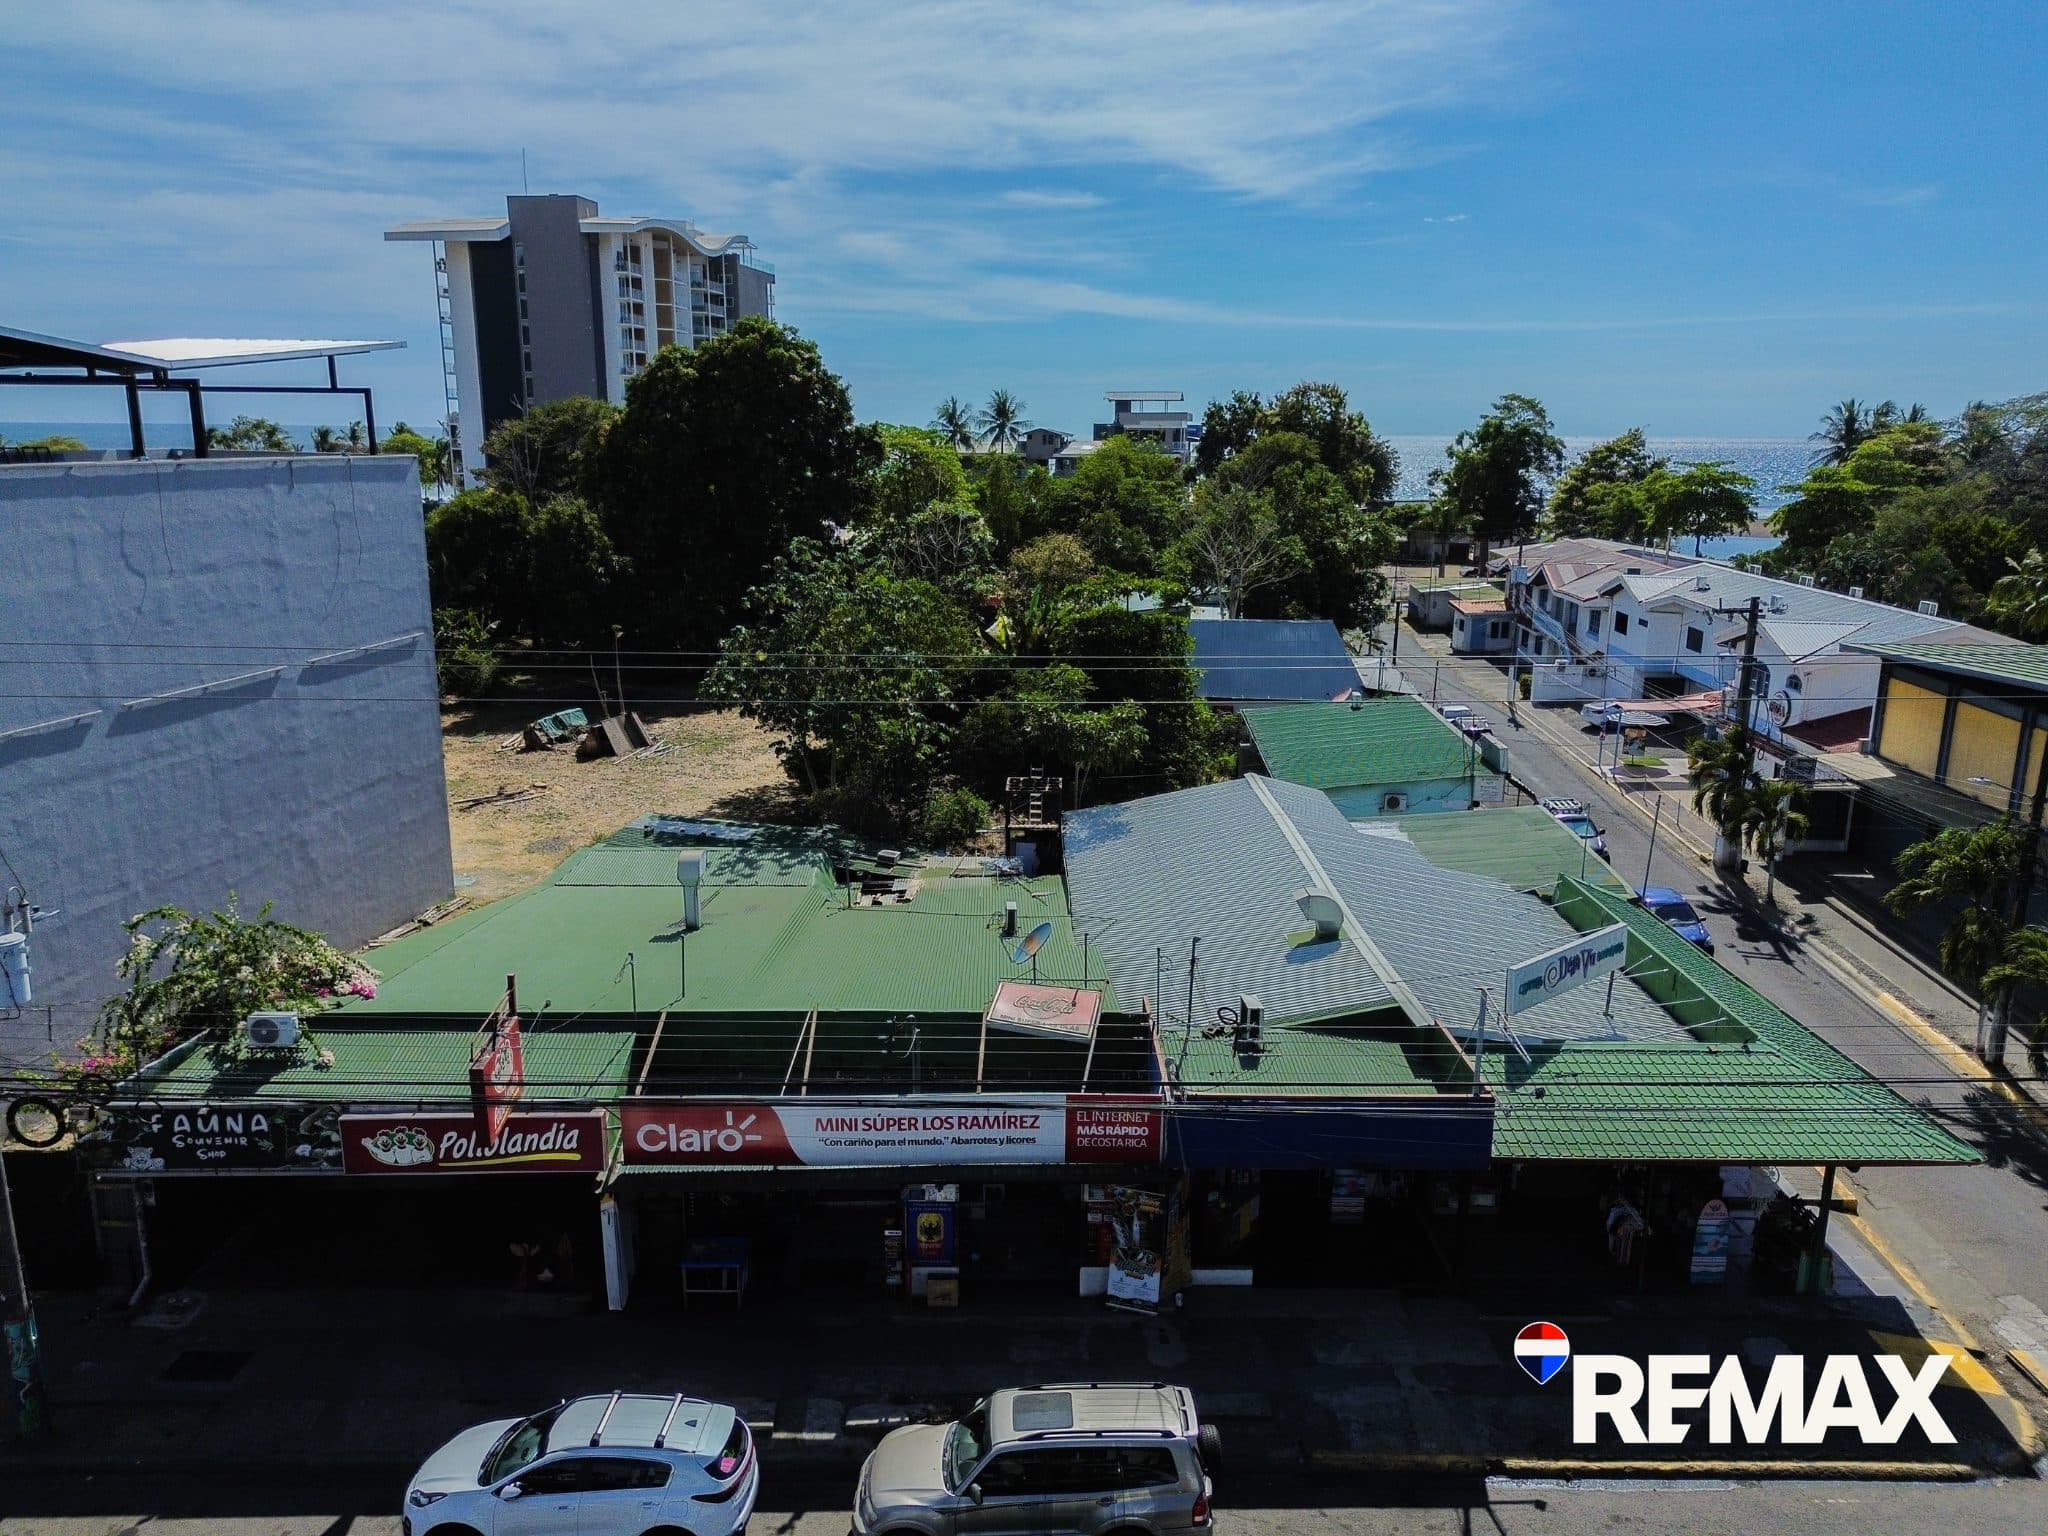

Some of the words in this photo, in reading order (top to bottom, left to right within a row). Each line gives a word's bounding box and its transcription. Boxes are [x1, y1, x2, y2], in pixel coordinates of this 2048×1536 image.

[152, 1113, 268, 1134] FAUNA
[815, 1117, 858, 1132] MINI
[862, 1113, 918, 1132] SÚPER
[923, 1116, 955, 1131] LOS
[957, 1111, 1040, 1130] RAMÍREZ
[1076, 1111, 1091, 1122] EL
[1092, 1111, 1150, 1123] INTERNET
[1077, 1123, 1105, 1135] MÁS
[1106, 1123, 1149, 1136] RÁPIDO
[172, 1135, 248, 1148] SOUVENIR
[636, 1124, 743, 1152] Claro
[843, 1137, 873, 1147] cariño
[874, 1138, 896, 1148] para
[897, 1137, 906, 1146] el
[950, 1136, 998, 1146] Abarrotes
[1005, 1135, 1037, 1145] licores
[1077, 1137, 1090, 1147] DE
[1091, 1137, 1124, 1148] COSTA
[1124, 1137, 1148, 1148] RICA
[196, 1149, 226, 1160] SHOP
